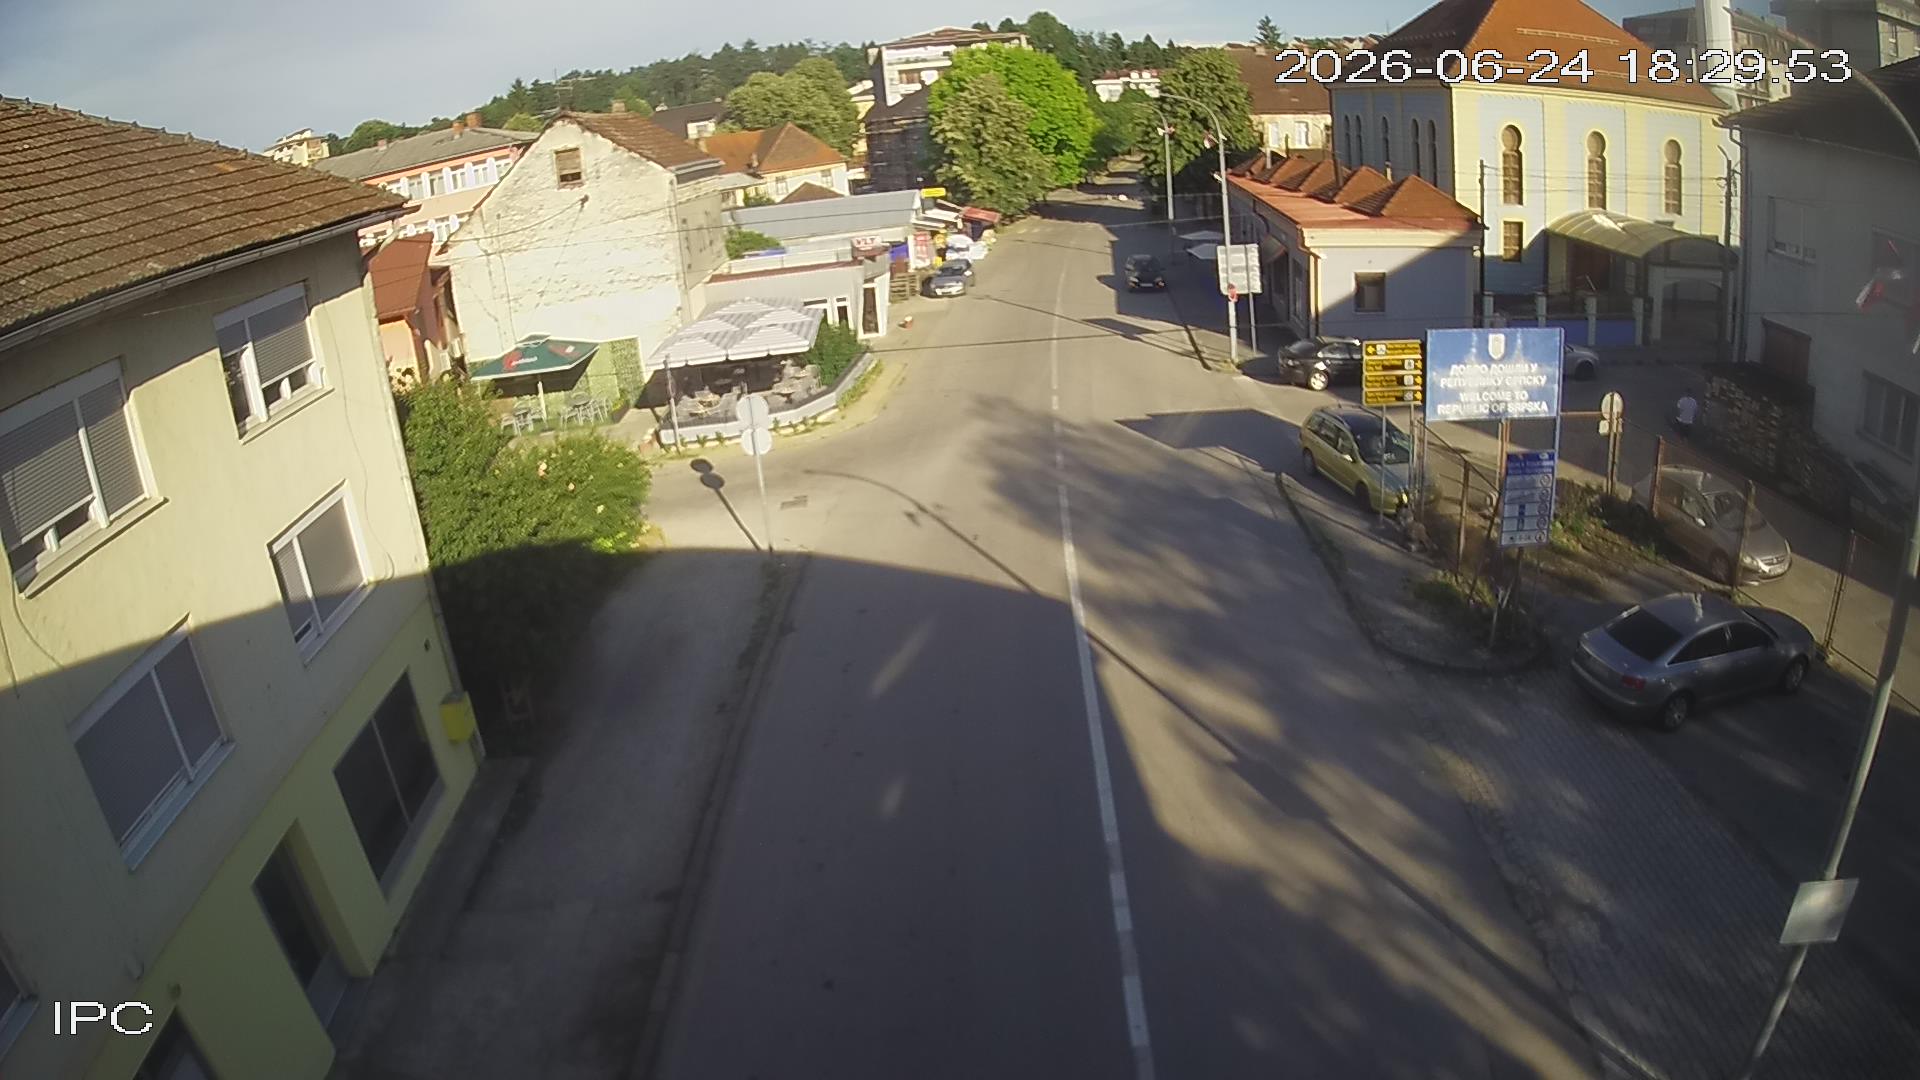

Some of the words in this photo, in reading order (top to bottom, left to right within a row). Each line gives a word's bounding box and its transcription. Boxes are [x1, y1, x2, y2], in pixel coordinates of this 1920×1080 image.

[1459, 391, 1512, 402] WELCOME
[1514, 390, 1529, 401] TO
[1437, 403, 1490, 416] REPUBLIC
[1492, 402, 1506, 413] OF
[1507, 400, 1549, 414] SRPSKA
